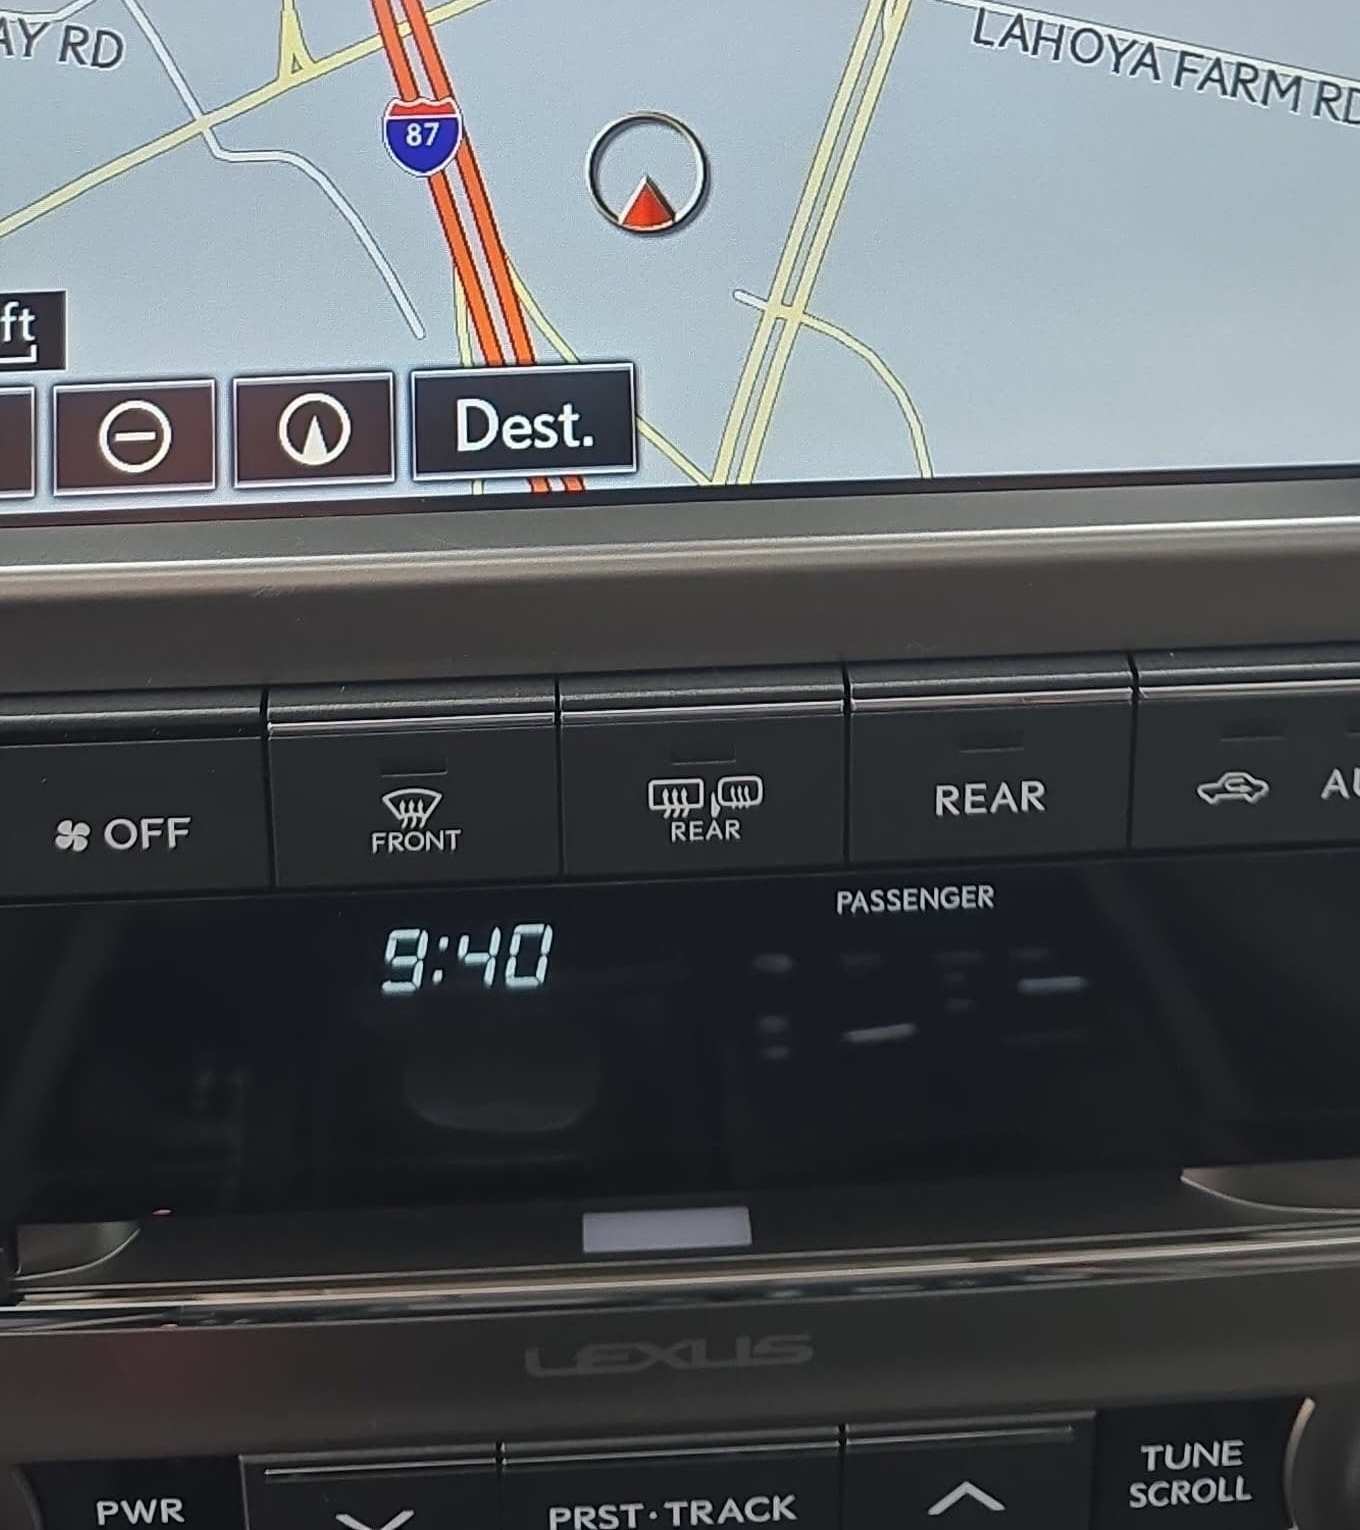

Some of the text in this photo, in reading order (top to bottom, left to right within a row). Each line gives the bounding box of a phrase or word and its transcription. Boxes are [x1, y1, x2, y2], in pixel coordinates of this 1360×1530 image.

[59, 22, 126, 67] RD
[972, 6, 1162, 82] LAHOYA
[1172, 48, 1303, 112] FARM
[406, 123, 439, 148] 87
[455, 397, 595, 453] Dest.
[934, 779, 1047, 818] REAR
[103, 814, 193, 852] OFF
[370, 827, 463, 857] FRONT
[669, 820, 742, 843] REAR
[836, 883, 996, 916] PASSENGER
[380, 922, 555, 995] 9:40
[524, 1332, 816, 1379] LEXUS
[1140, 1439, 1245, 1473] TUNE
[1128, 1475, 1252, 1510] SCROLL
[95, 1496, 186, 1527] PWR
